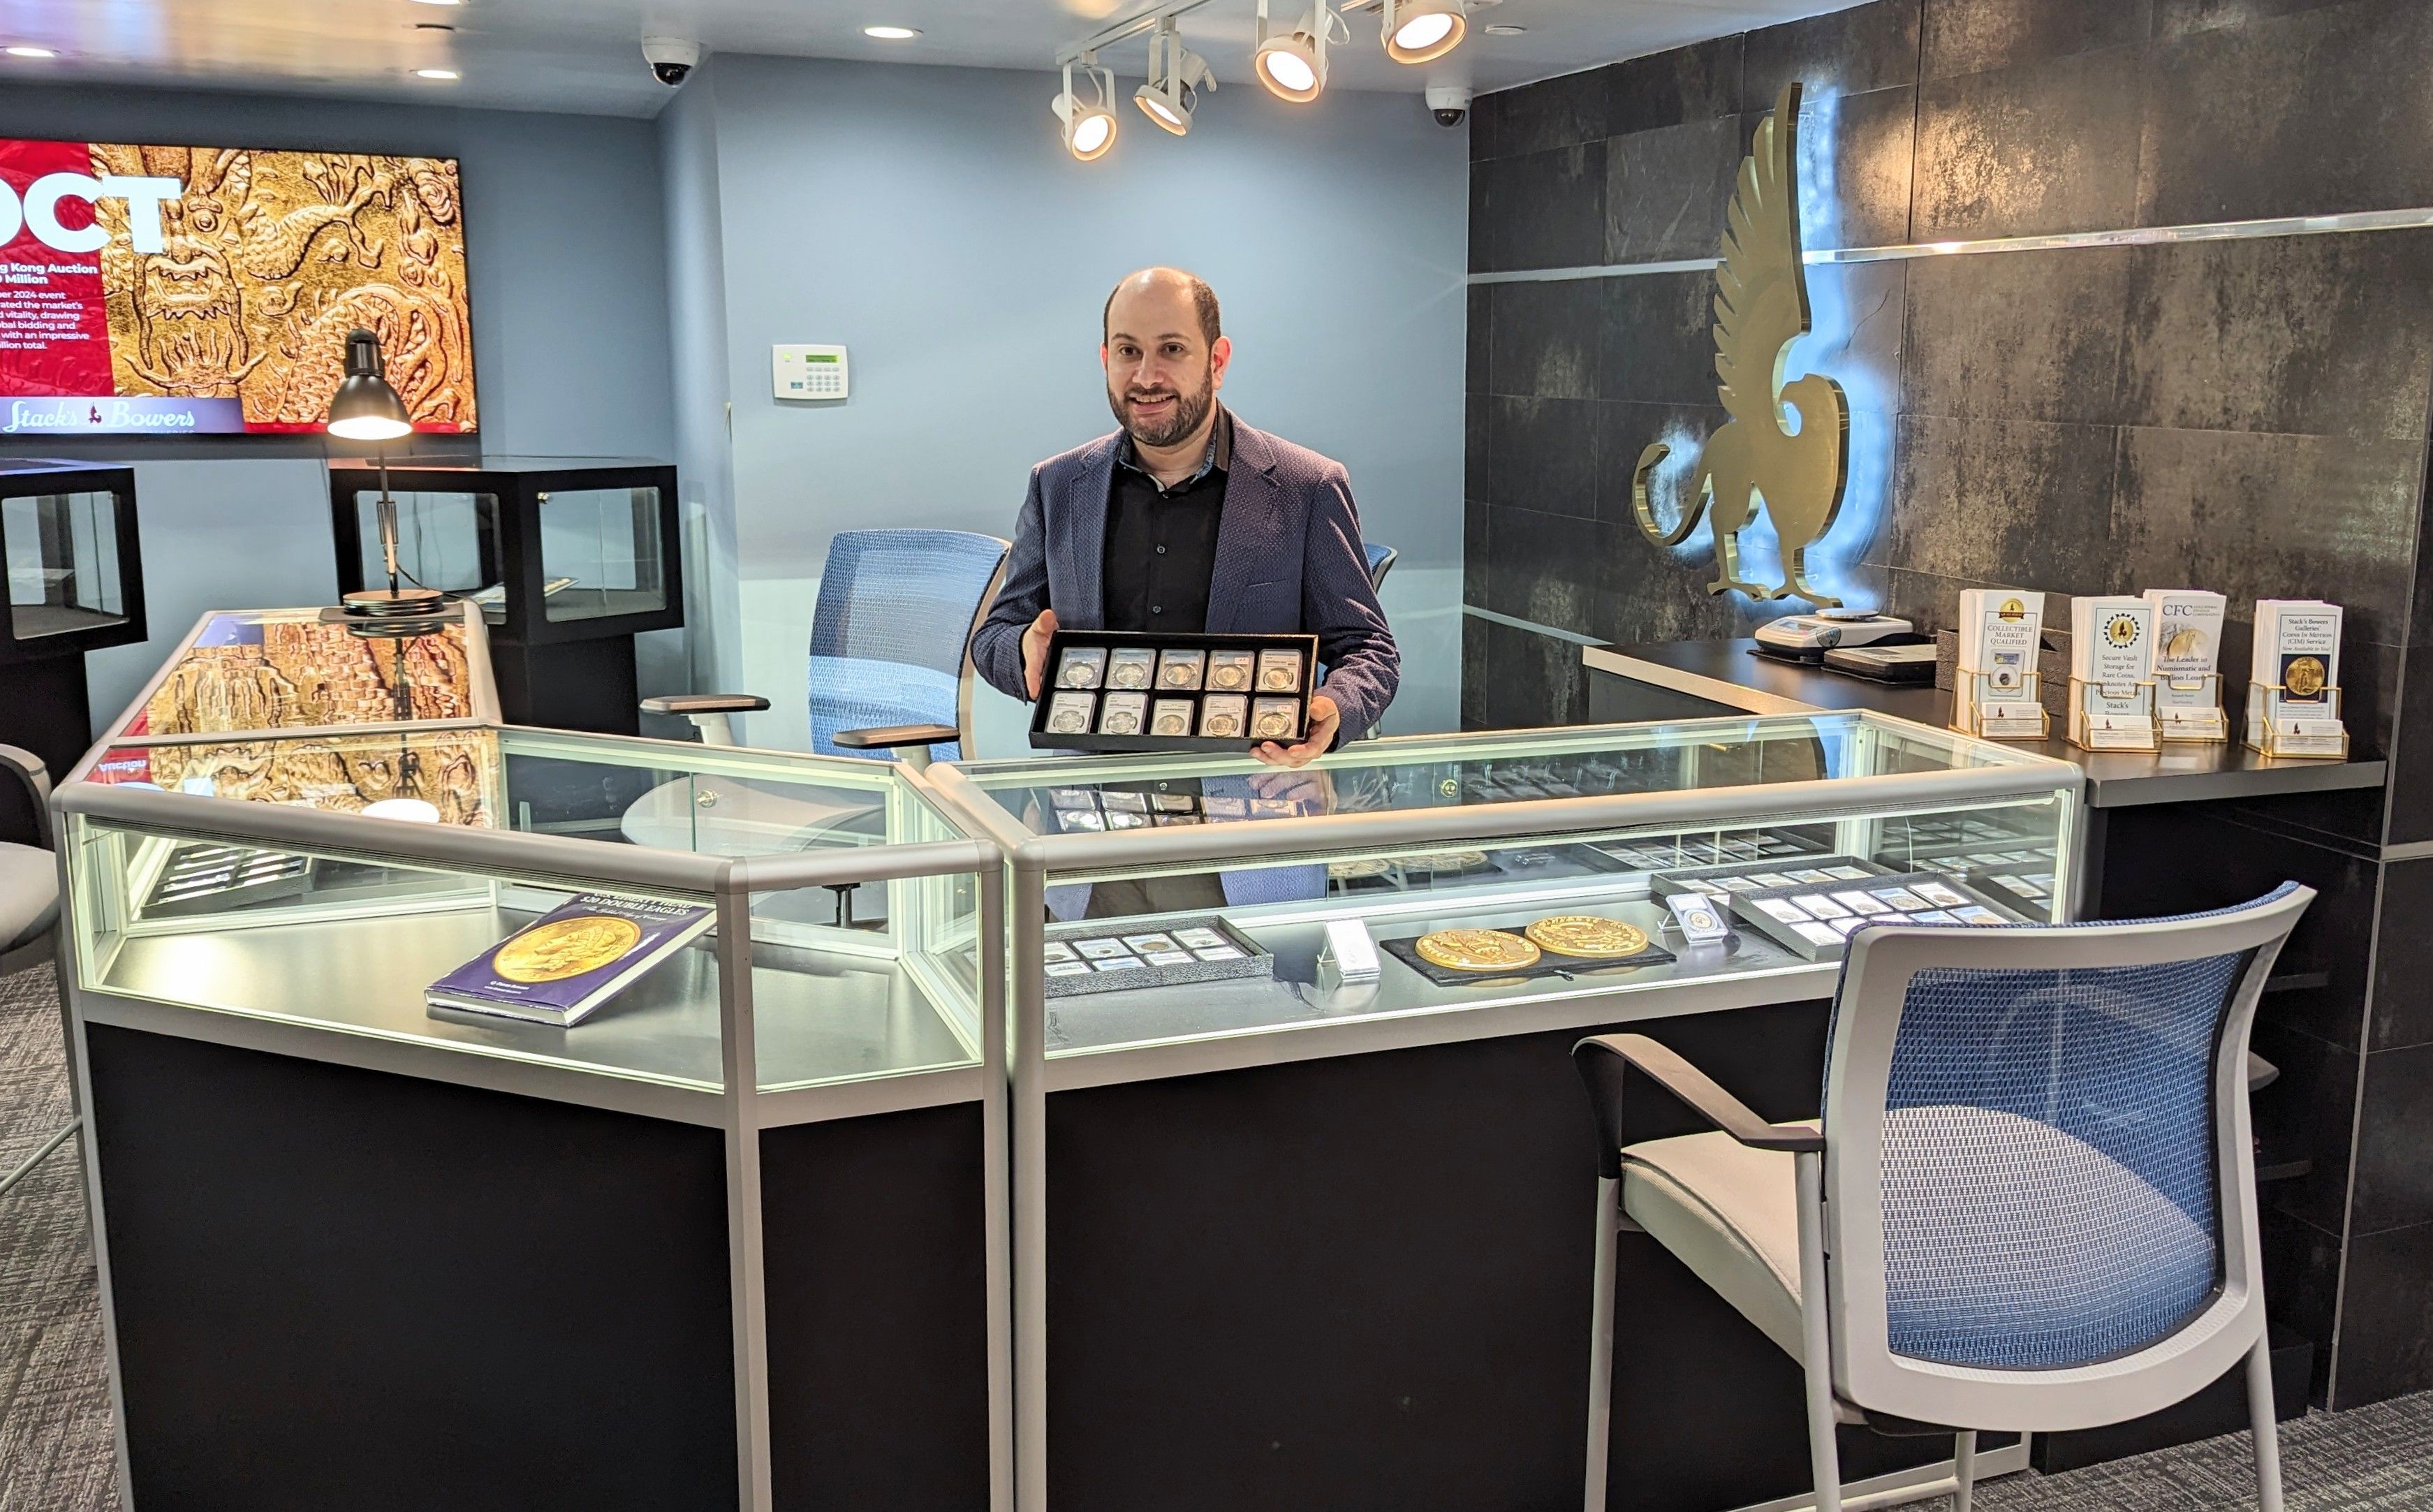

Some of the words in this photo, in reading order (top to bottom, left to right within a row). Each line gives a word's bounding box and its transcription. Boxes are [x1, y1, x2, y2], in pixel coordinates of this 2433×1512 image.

[0, 171, 181, 254] CT
[10, 263, 45, 274] Kong
[47, 263, 98, 274] Auction
[5, 273, 49, 284] Million
[13, 291, 37, 299] 2024
[6, 311, 39, 321] vitality,
[41, 311, 80, 321] drawing
[17, 321, 55, 331] bidding
[57, 321, 76, 330] and
[1, 330, 23, 339] with
[38, 330, 90, 341] impressive
[22, 341, 48, 349] total.
[2, 400, 78, 433] Stack's
[108, 400, 196, 427] Bowers
[2162, 604, 2193, 616] CFC
[1987, 624, 2033, 633] COLLECTIBLE
[580, 895, 601, 904] $20
[598, 898, 648, 911] DOUBLE
[644, 903, 690, 916] EAGLES
